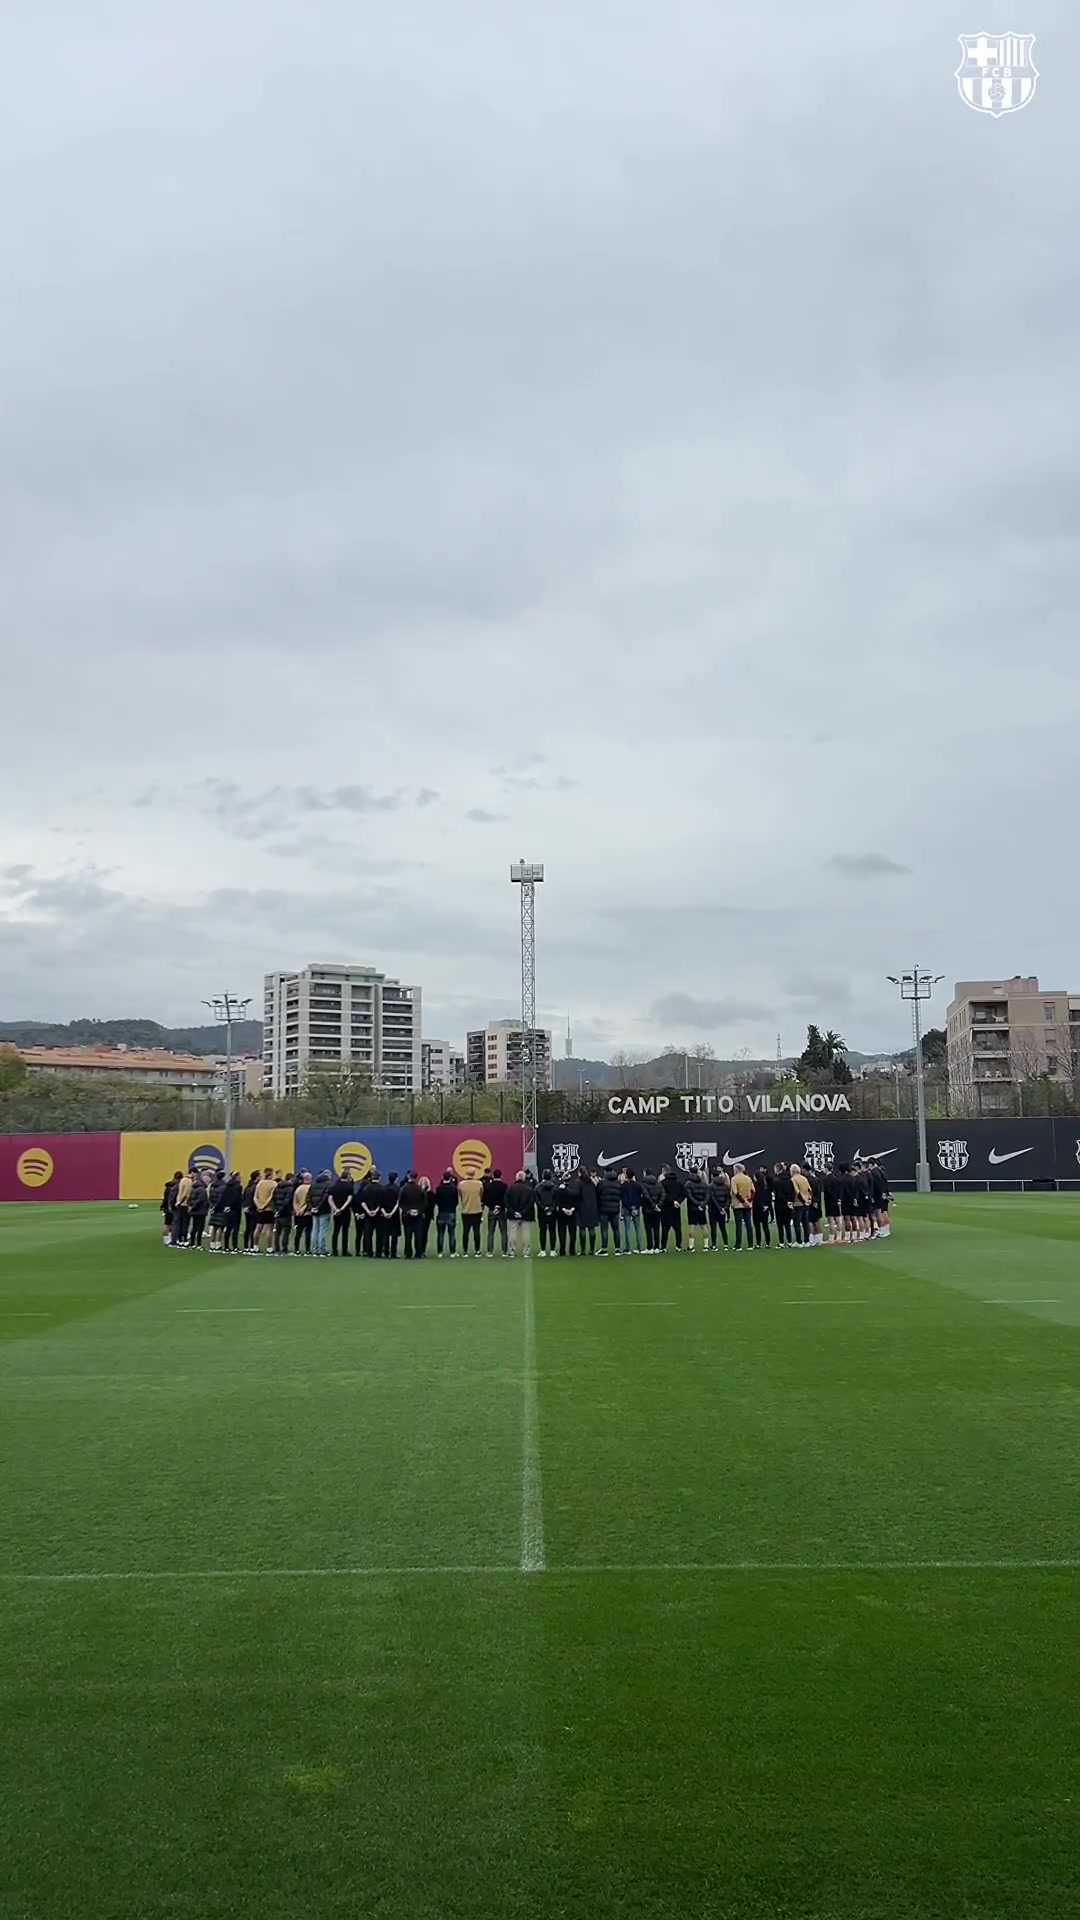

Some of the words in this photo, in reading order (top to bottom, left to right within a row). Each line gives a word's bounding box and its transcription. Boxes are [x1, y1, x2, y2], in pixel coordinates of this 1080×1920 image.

[608, 1096, 670, 1114] CAMP
[680, 1095, 734, 1113] TITO
[746, 1093, 852, 1113] VILANOVA
